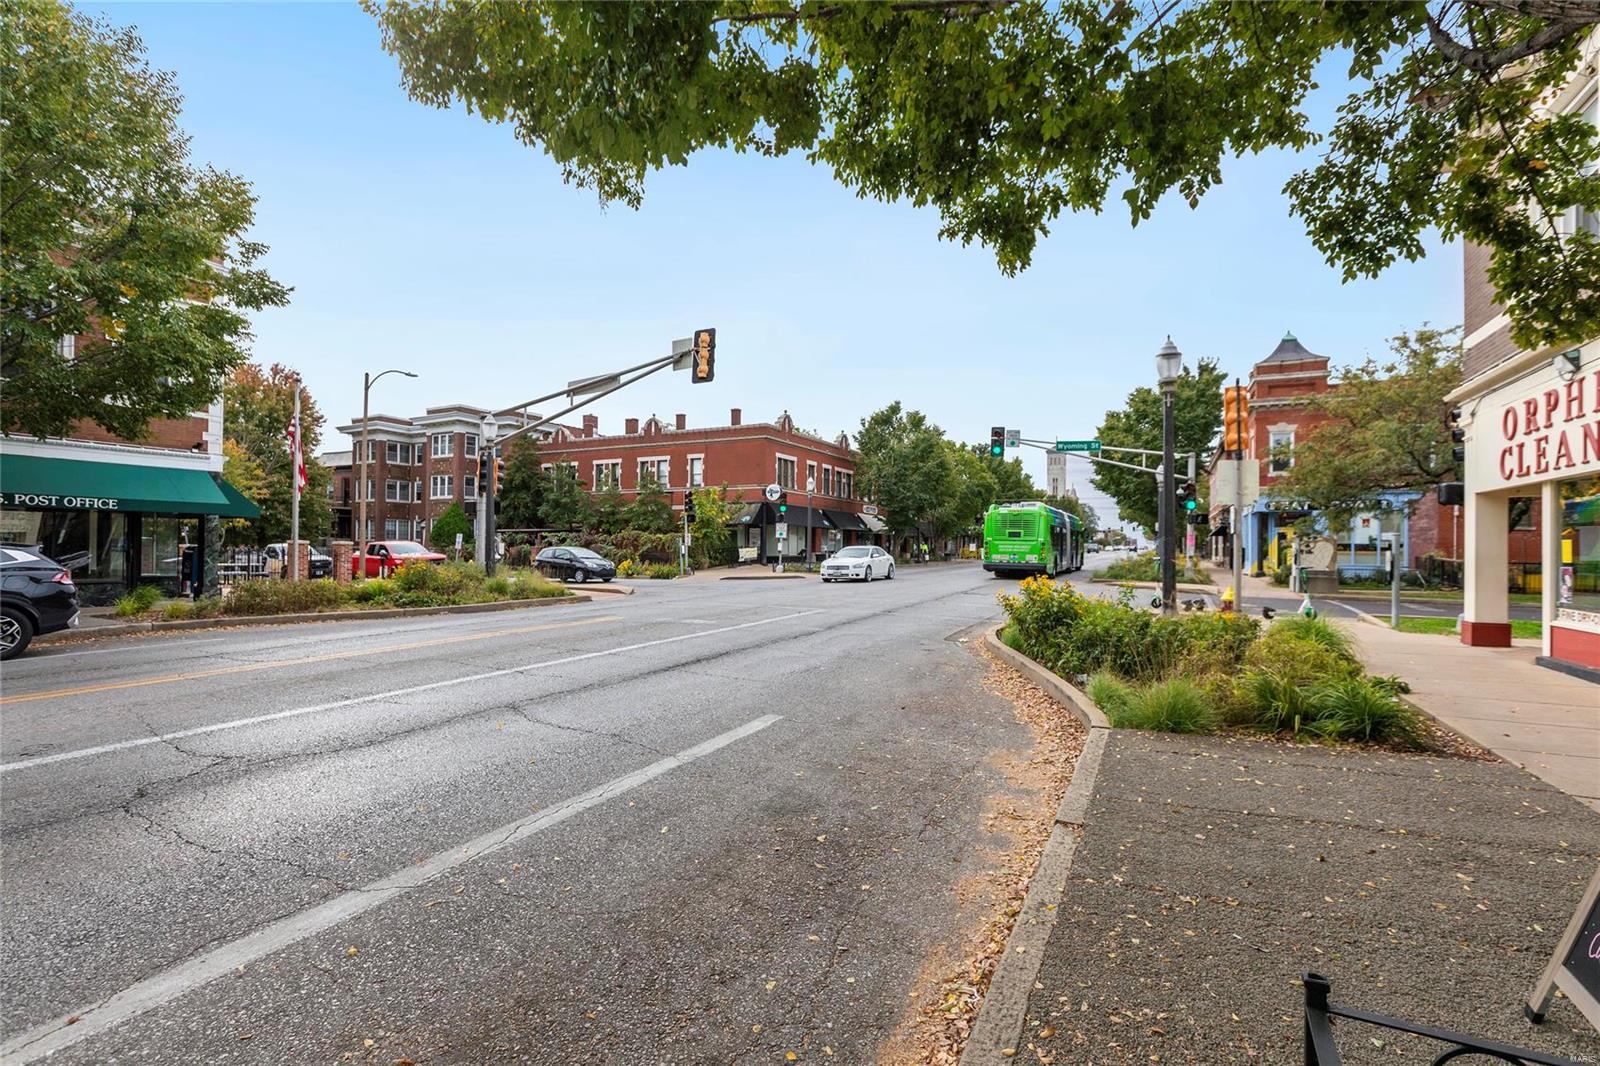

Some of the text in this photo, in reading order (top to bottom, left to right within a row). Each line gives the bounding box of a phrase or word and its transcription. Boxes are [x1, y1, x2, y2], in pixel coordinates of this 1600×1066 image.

[1057, 442, 1088, 450] Wyoming
[1499, 420, 1600, 480] CLEAN
[14, 494, 60, 506] POST
[63, 496, 118, 509] OFFICE
